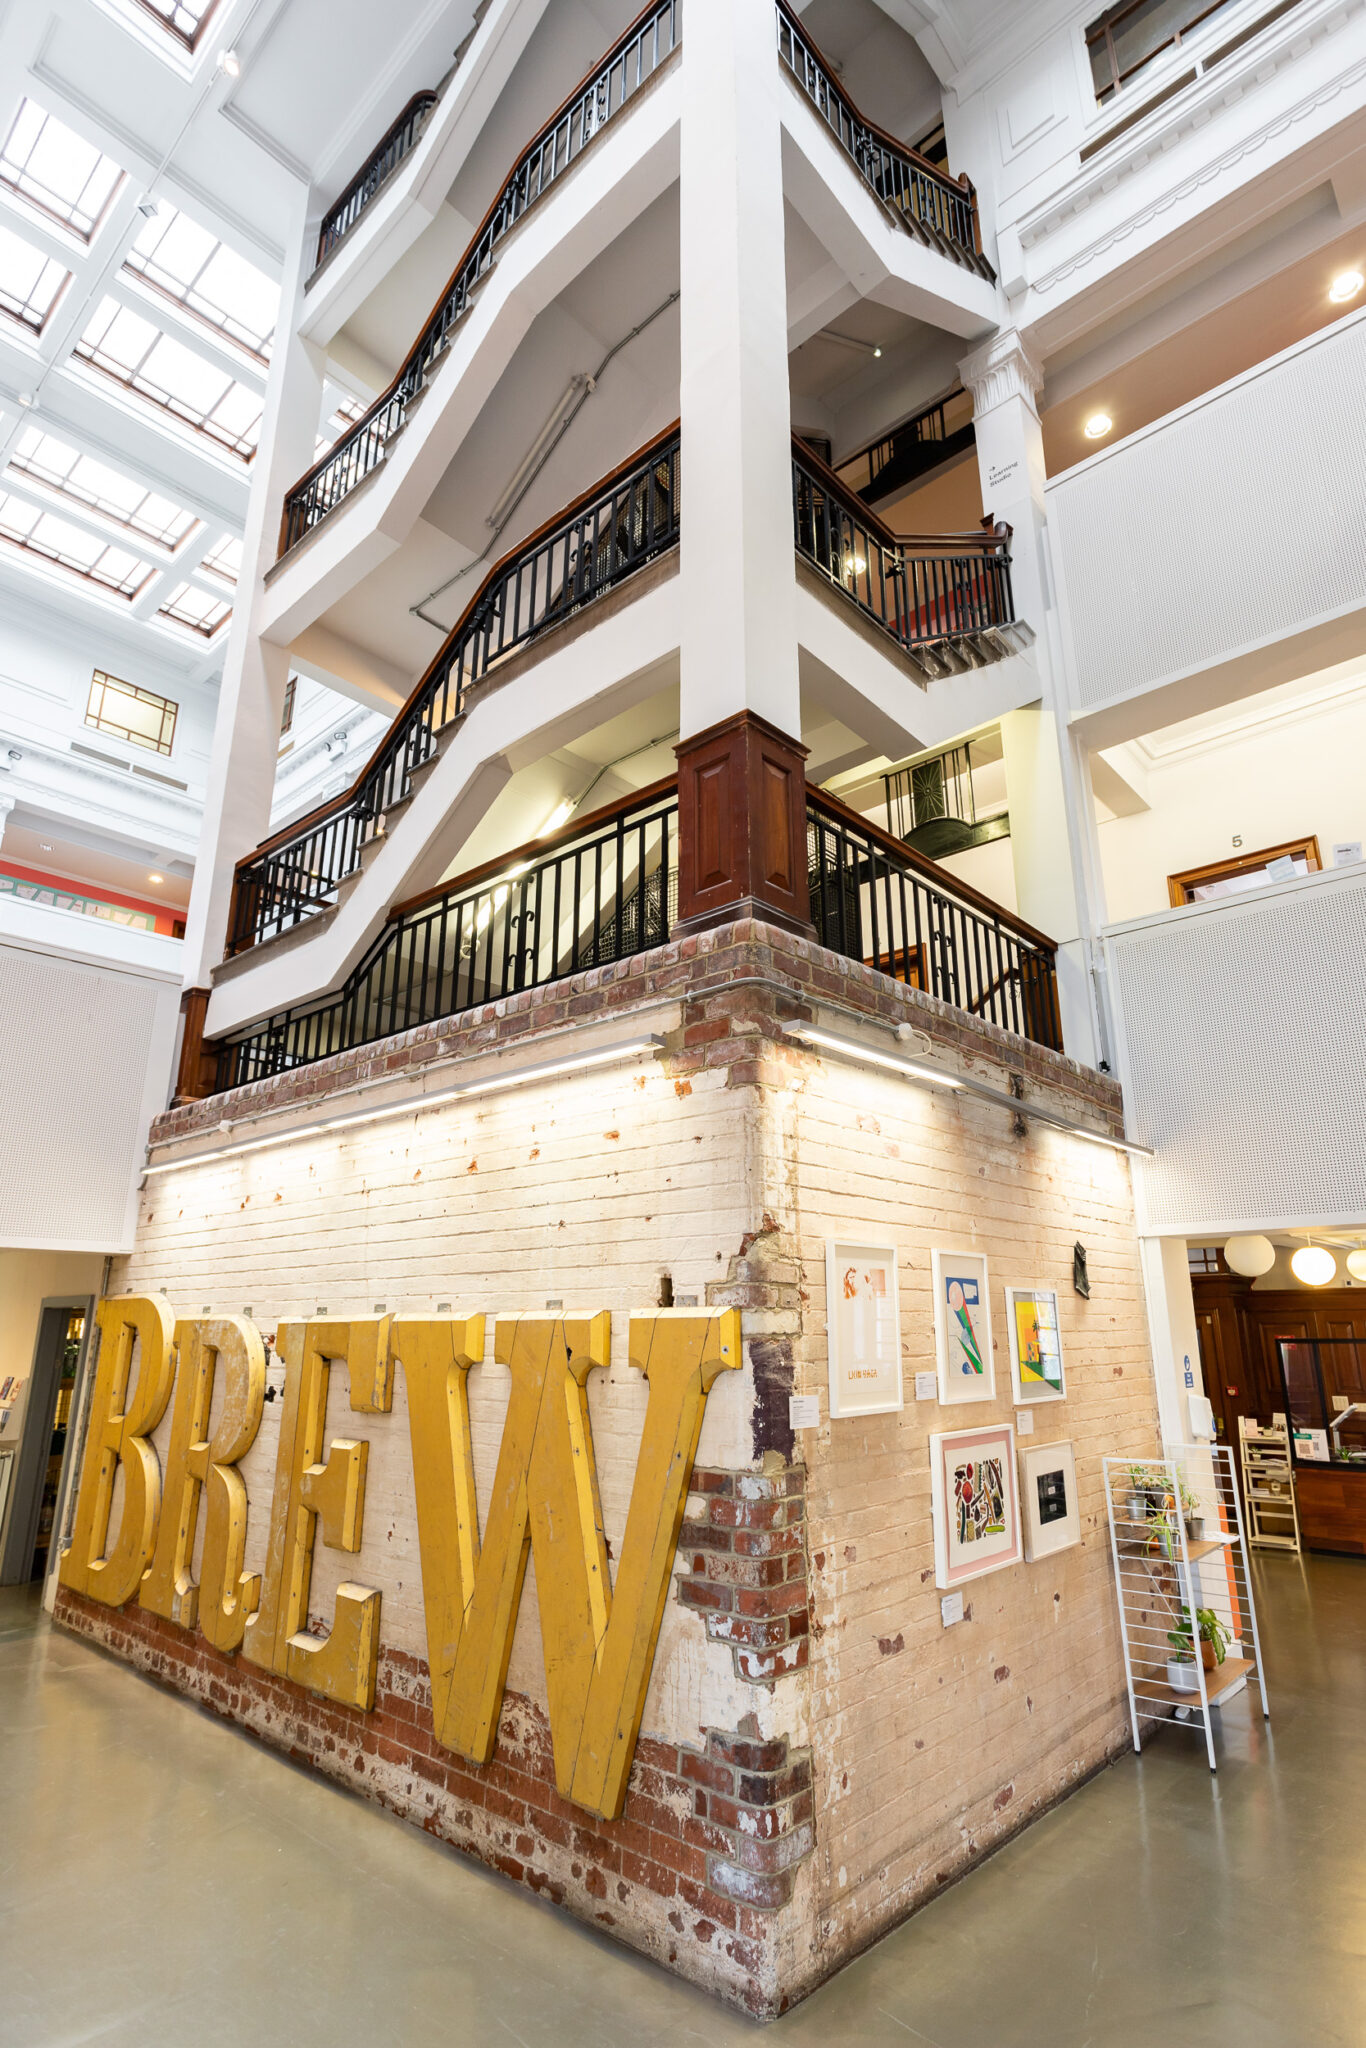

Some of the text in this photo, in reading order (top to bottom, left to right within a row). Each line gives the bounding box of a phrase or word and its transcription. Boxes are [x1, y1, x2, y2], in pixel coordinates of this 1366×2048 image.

[989, 461, 1018, 480] Learning
[990, 473, 1012, 488] Studio
[1232, 835, 1243, 848] 5
[58, 1291, 743, 1822] BREW
